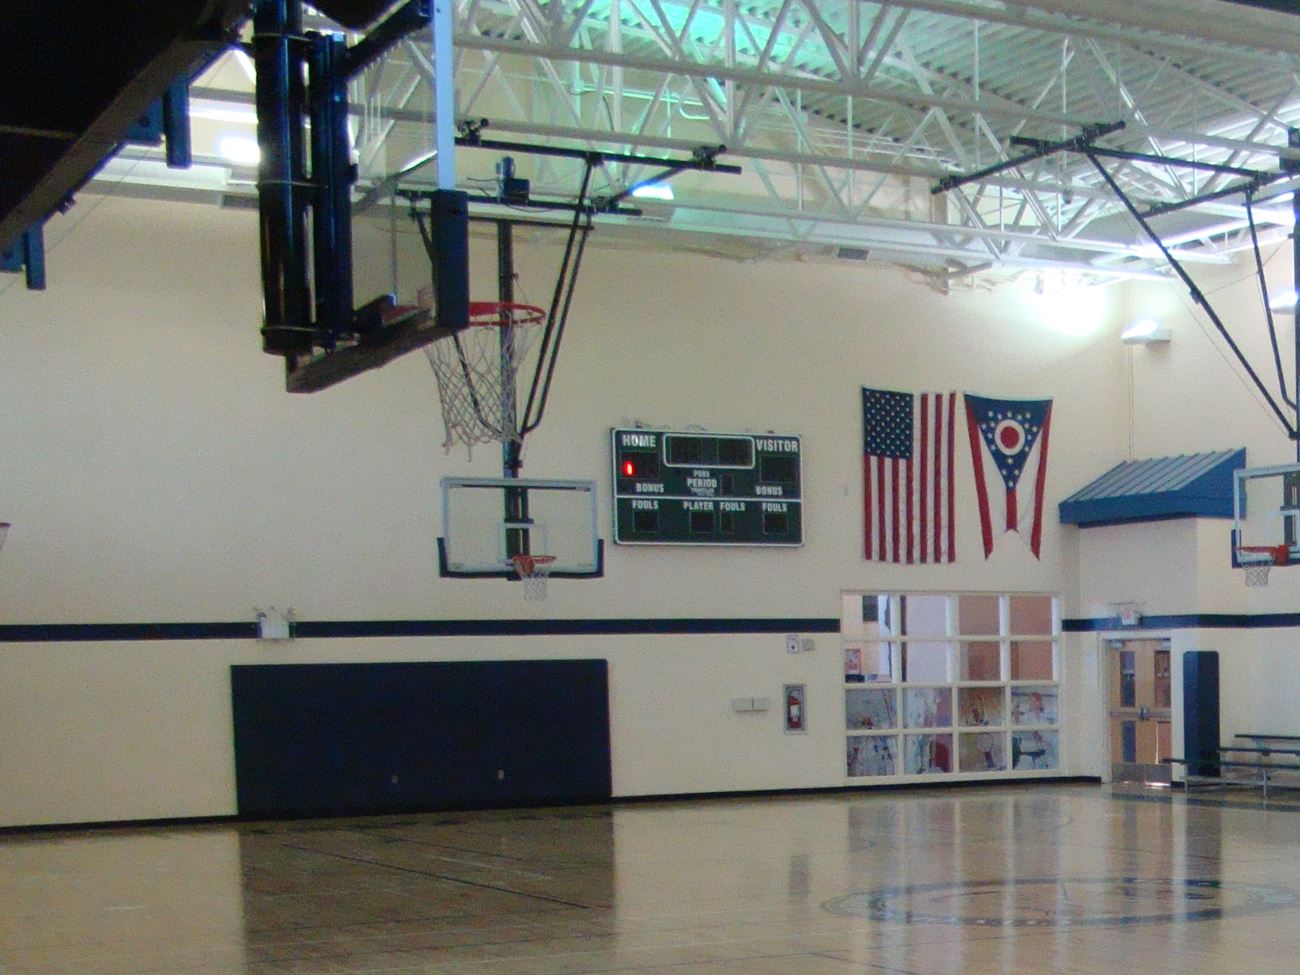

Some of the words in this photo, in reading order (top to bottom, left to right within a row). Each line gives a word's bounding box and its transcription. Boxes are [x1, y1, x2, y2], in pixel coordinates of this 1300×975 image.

[622, 434, 656, 448] HOME
[755, 438, 798, 453] VISITOR
[636, 483, 664, 494] BONUS
[687, 478, 717, 489] PERIOD
[755, 485, 783, 496] BONUS
[632, 500, 659, 510] FOULS
[683, 501, 714, 511] PLAYER
[719, 502, 746, 512] FOULS
[762, 502, 788, 512] FOULS
